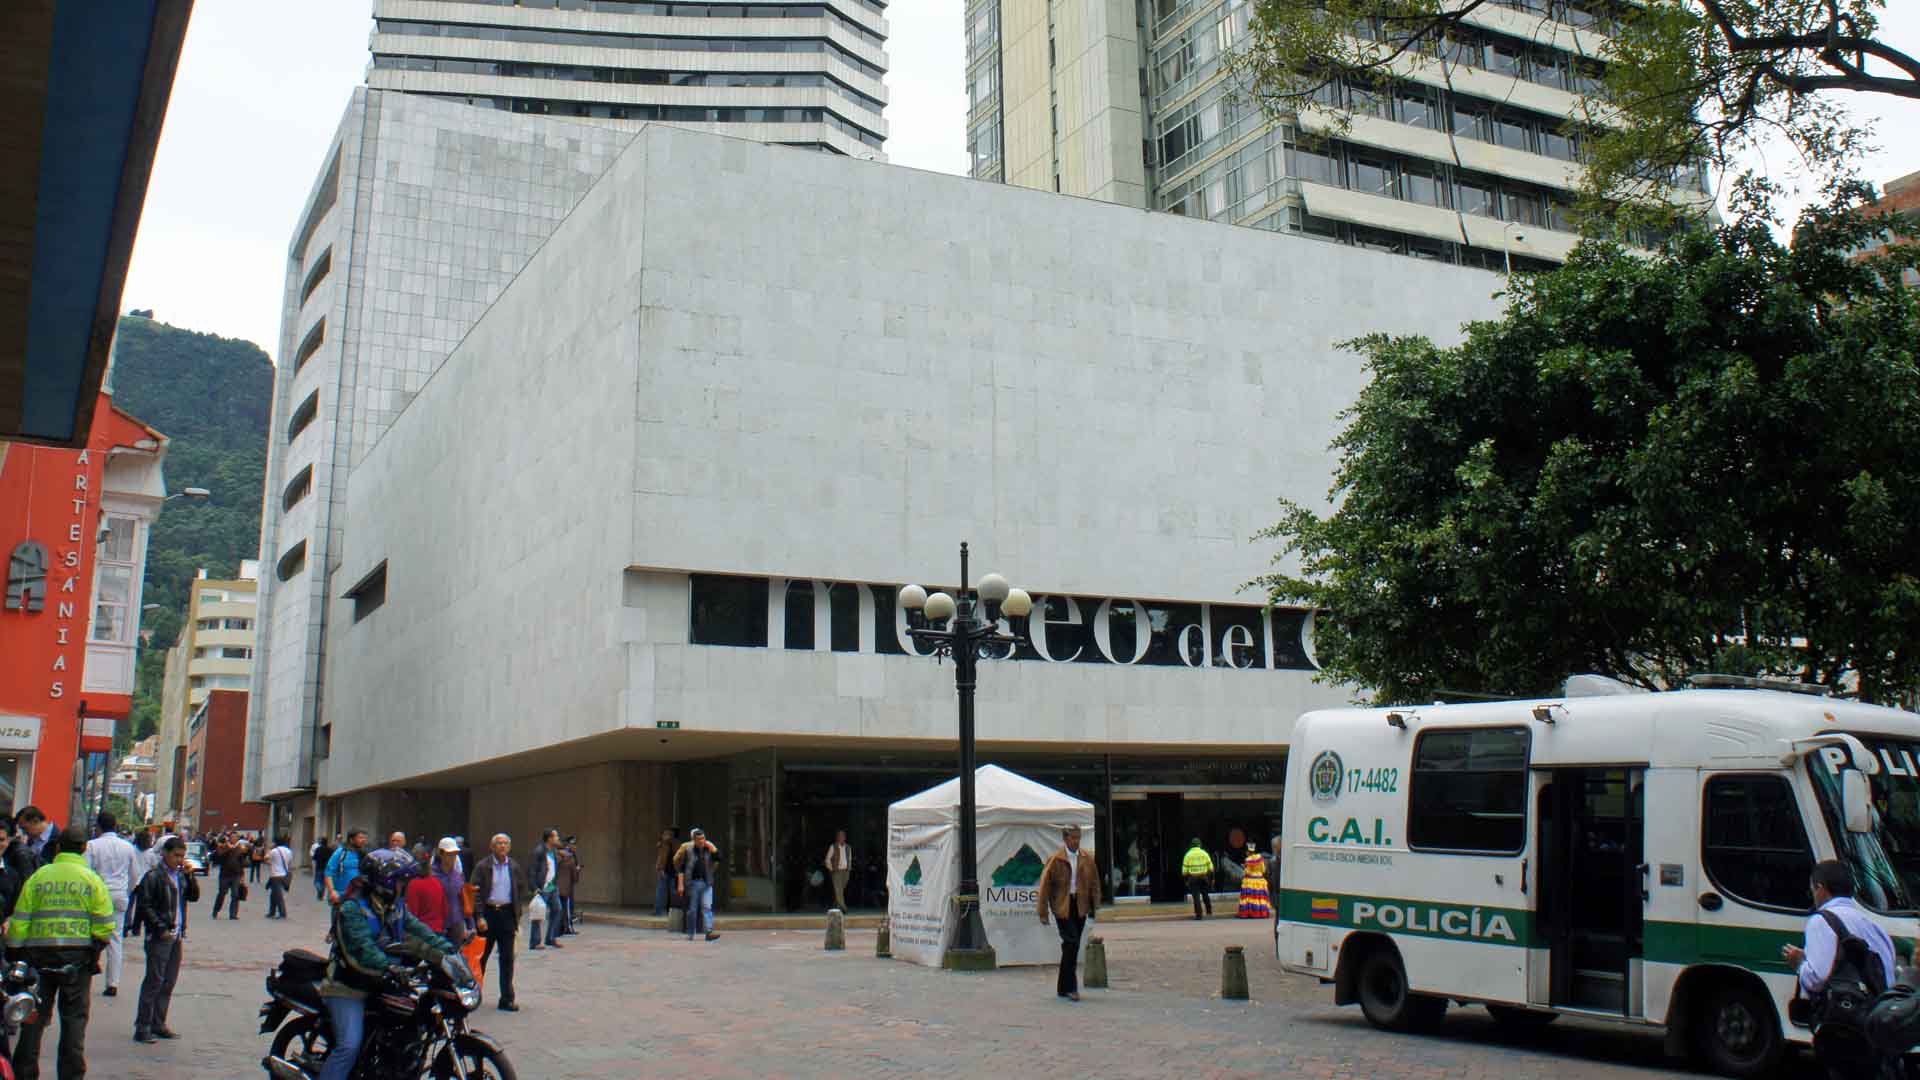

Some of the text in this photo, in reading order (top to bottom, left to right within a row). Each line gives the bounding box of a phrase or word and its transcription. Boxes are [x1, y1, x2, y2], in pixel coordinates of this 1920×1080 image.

[1178, 603, 1274, 669] del
[1819, 747, 1920, 777] PLI
[1347, 767, 1398, 792] 17-4482
[1307, 816, 1392, 846] C.A.I.
[35, 880, 92, 896] POLICIA
[986, 887, 1040, 903] Muse
[1352, 901, 1517, 941] POLICÍA
